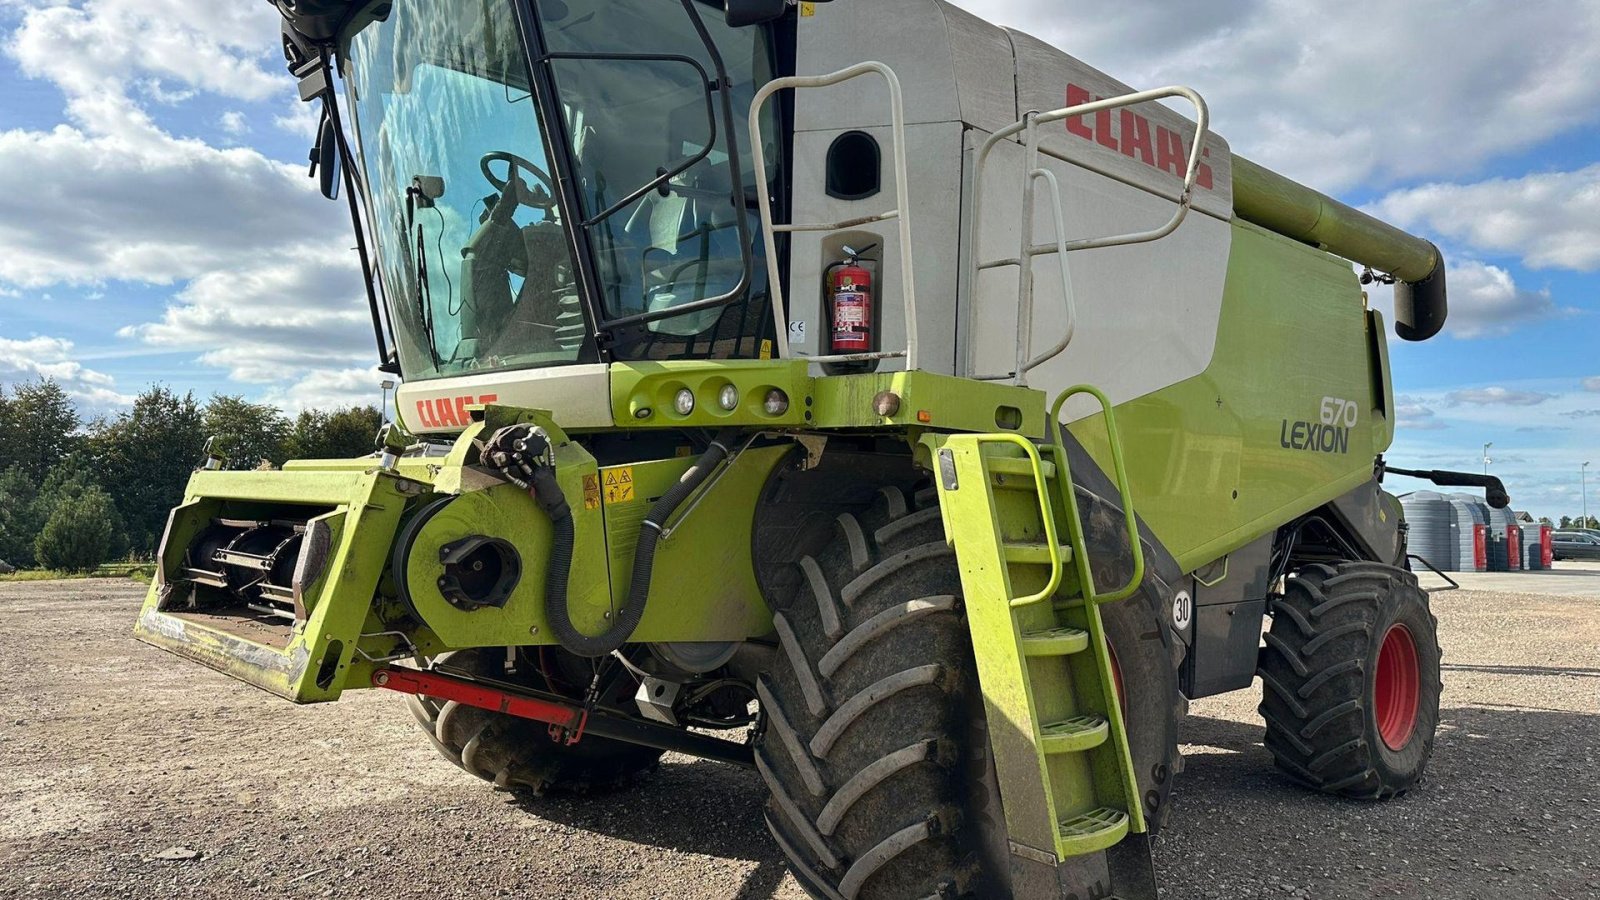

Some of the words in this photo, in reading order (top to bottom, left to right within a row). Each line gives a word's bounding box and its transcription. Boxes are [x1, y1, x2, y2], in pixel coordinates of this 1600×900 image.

[1320, 396, 1358, 428] 670
[1280, 419, 1349, 454] LEXION
[1176, 597, 1189, 622] 30
